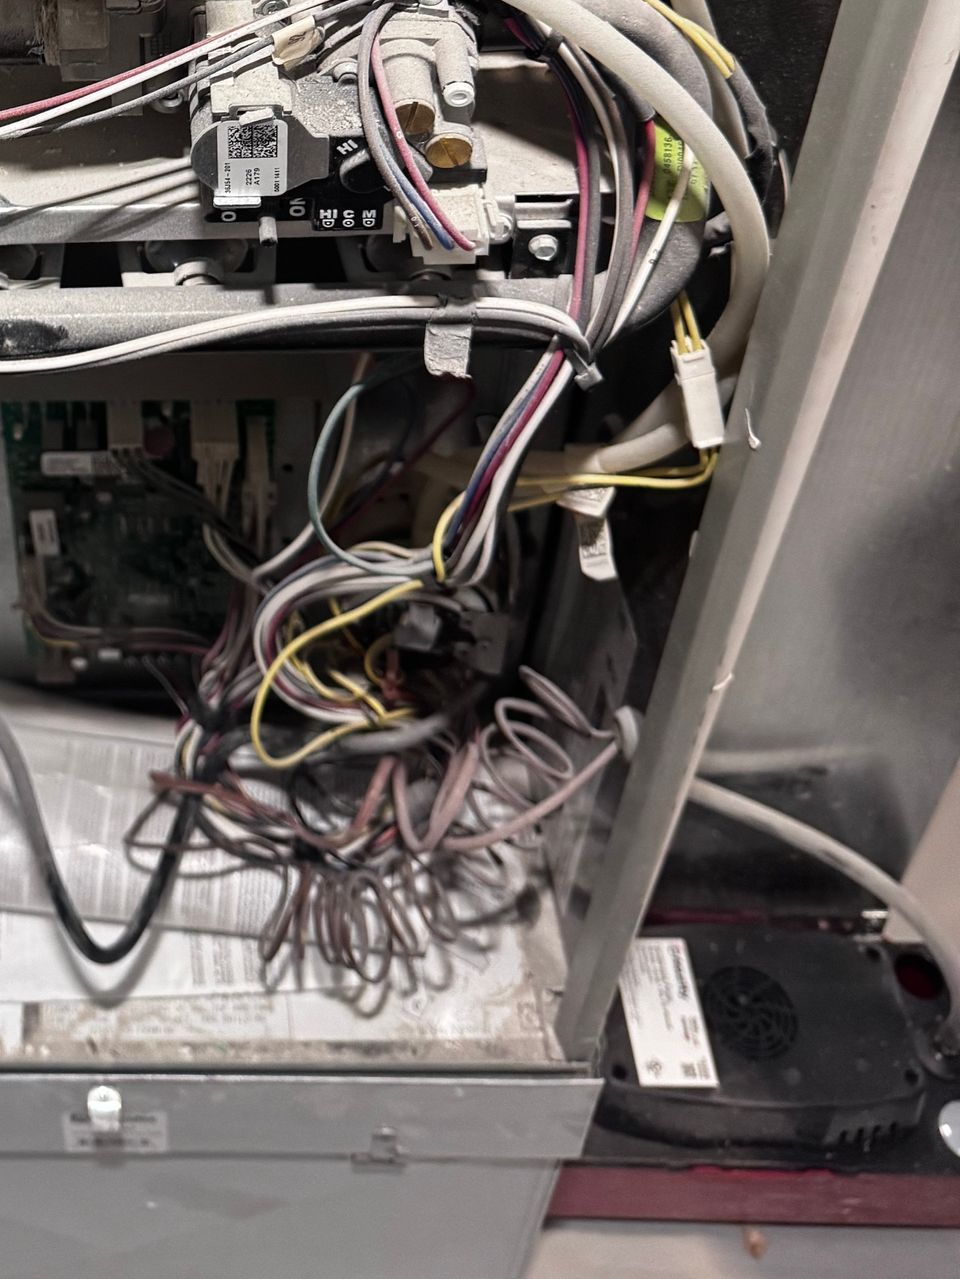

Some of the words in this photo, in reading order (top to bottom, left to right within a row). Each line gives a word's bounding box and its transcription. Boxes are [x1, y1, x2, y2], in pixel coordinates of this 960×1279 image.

[336, 139, 359, 155] HI
[253, 167, 261, 186] A179
[319, 208, 338, 219] HI
[342, 209, 355, 218] C
[362, 209, 377, 218] M
